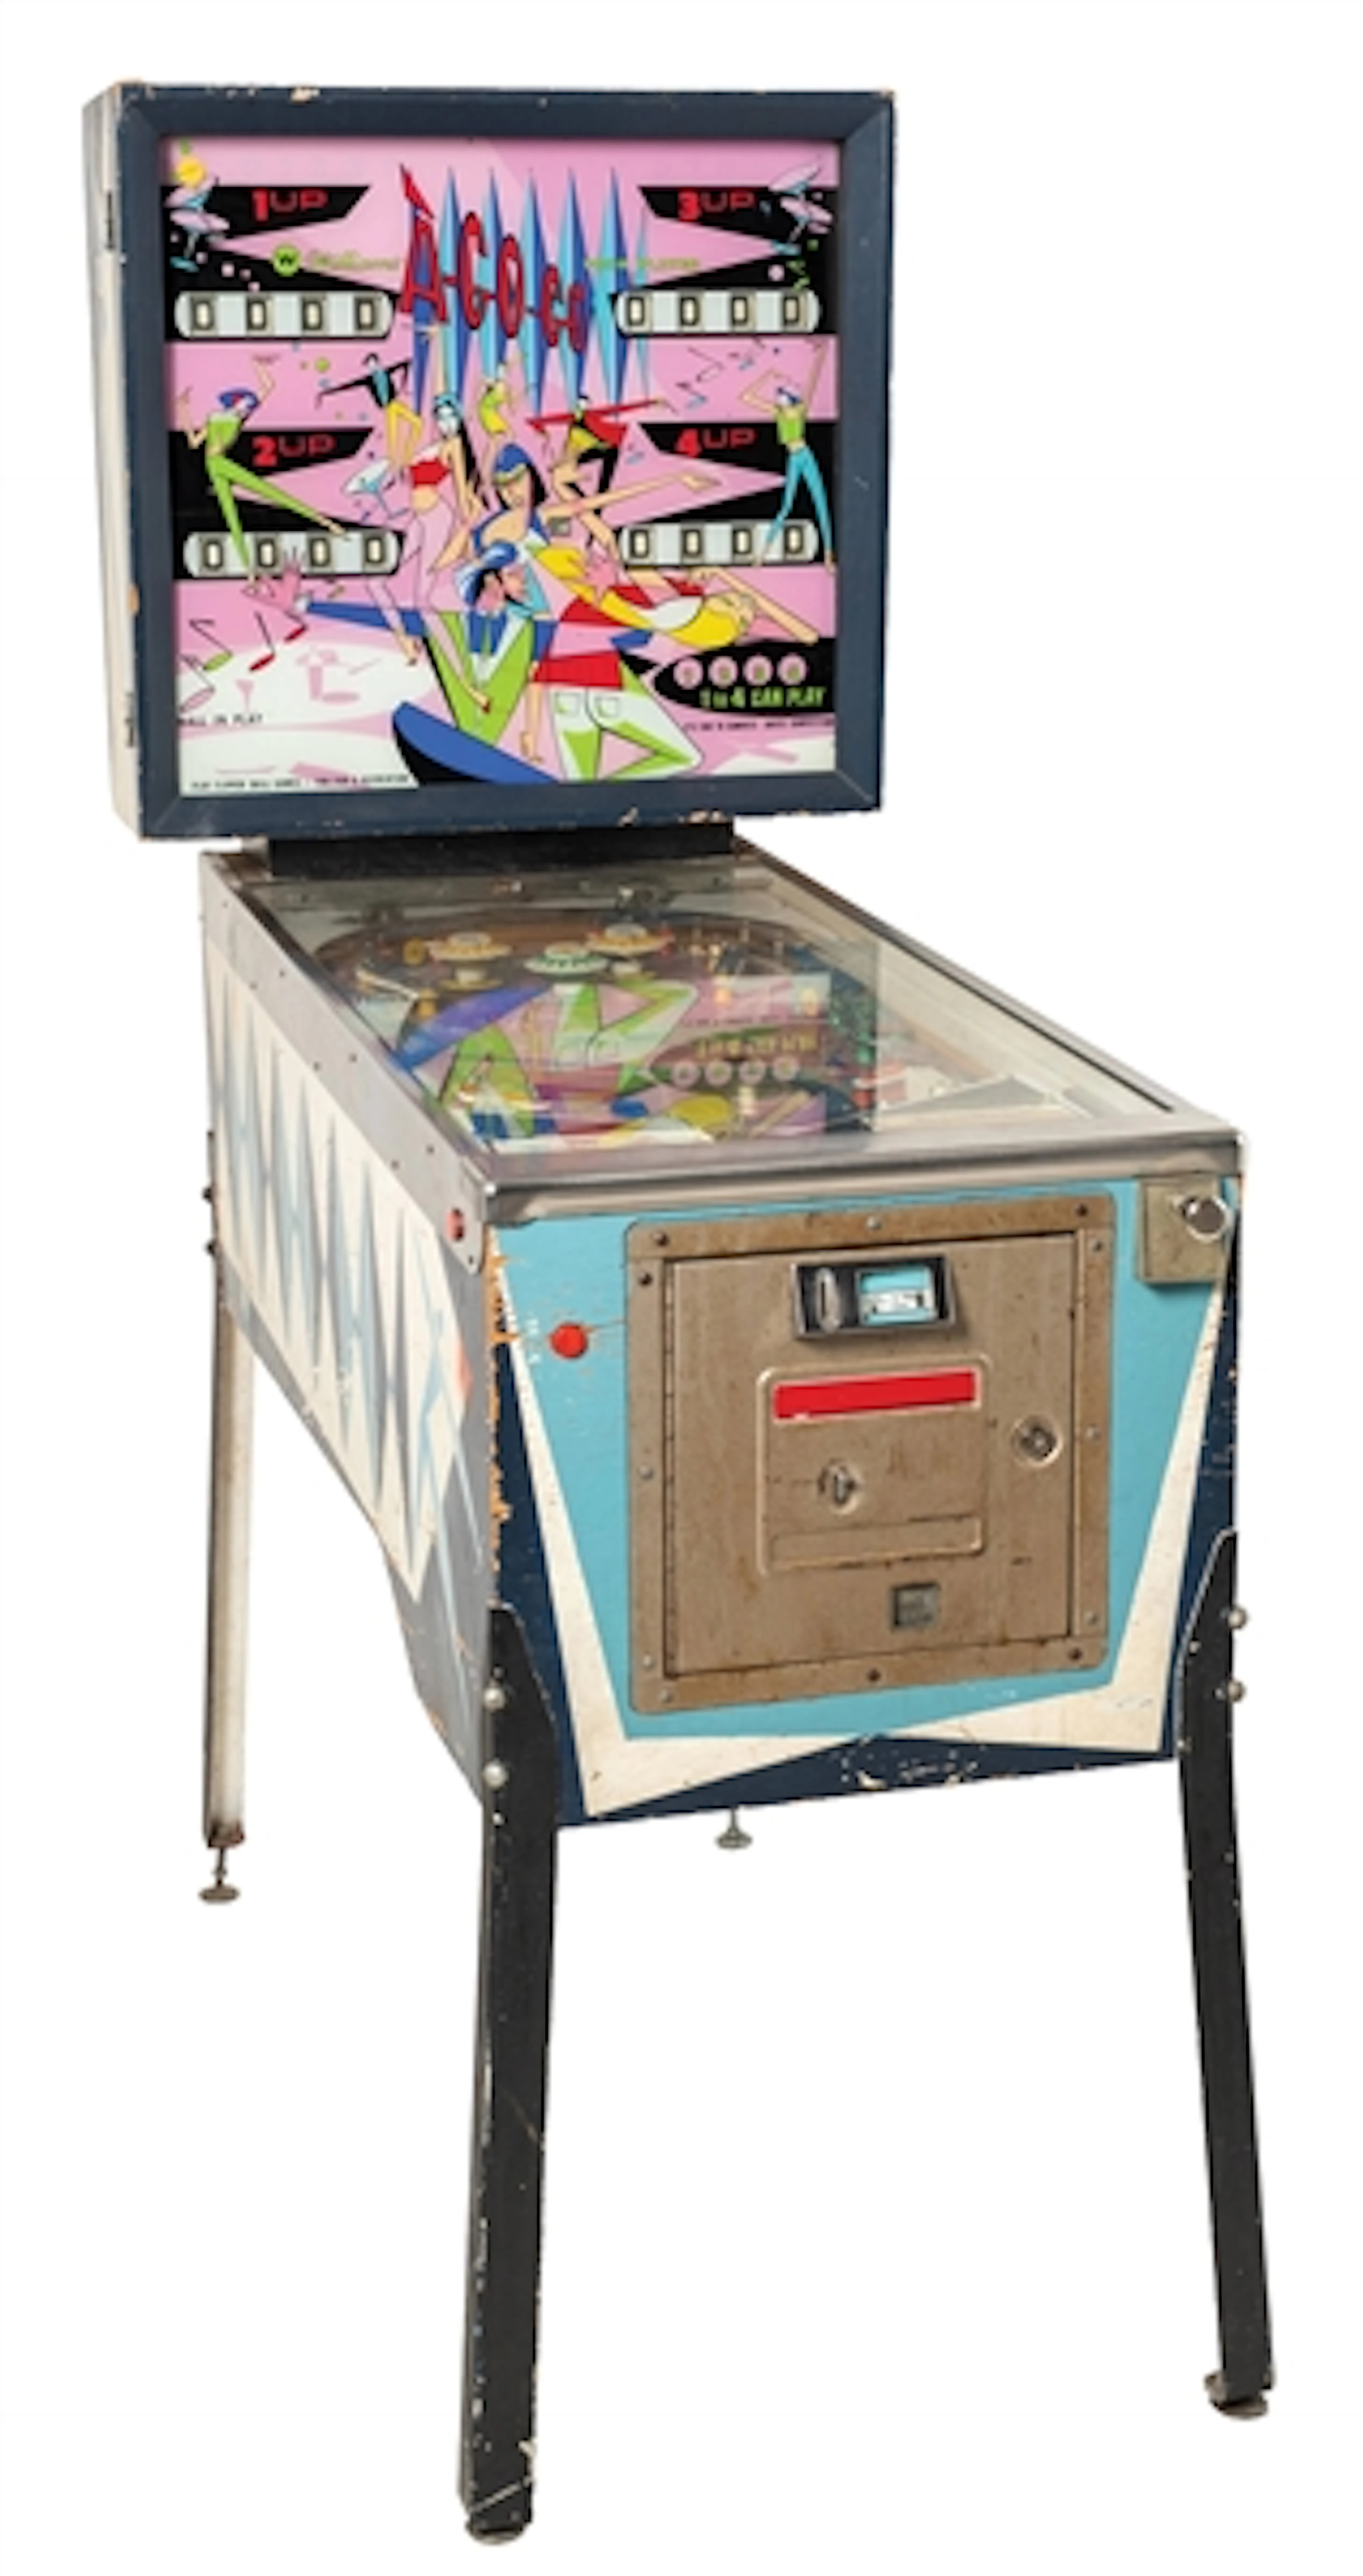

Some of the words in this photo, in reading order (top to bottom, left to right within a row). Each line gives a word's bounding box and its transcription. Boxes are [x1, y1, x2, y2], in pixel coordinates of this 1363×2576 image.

[251, 189, 329, 222] 1UP
[677, 190, 757, 222] 3UP
[251, 433, 338, 467] 2UP
[676, 427, 758, 458] 4UP
[750, 687, 783, 708] CAN
[785, 686, 827, 707] PLAY
